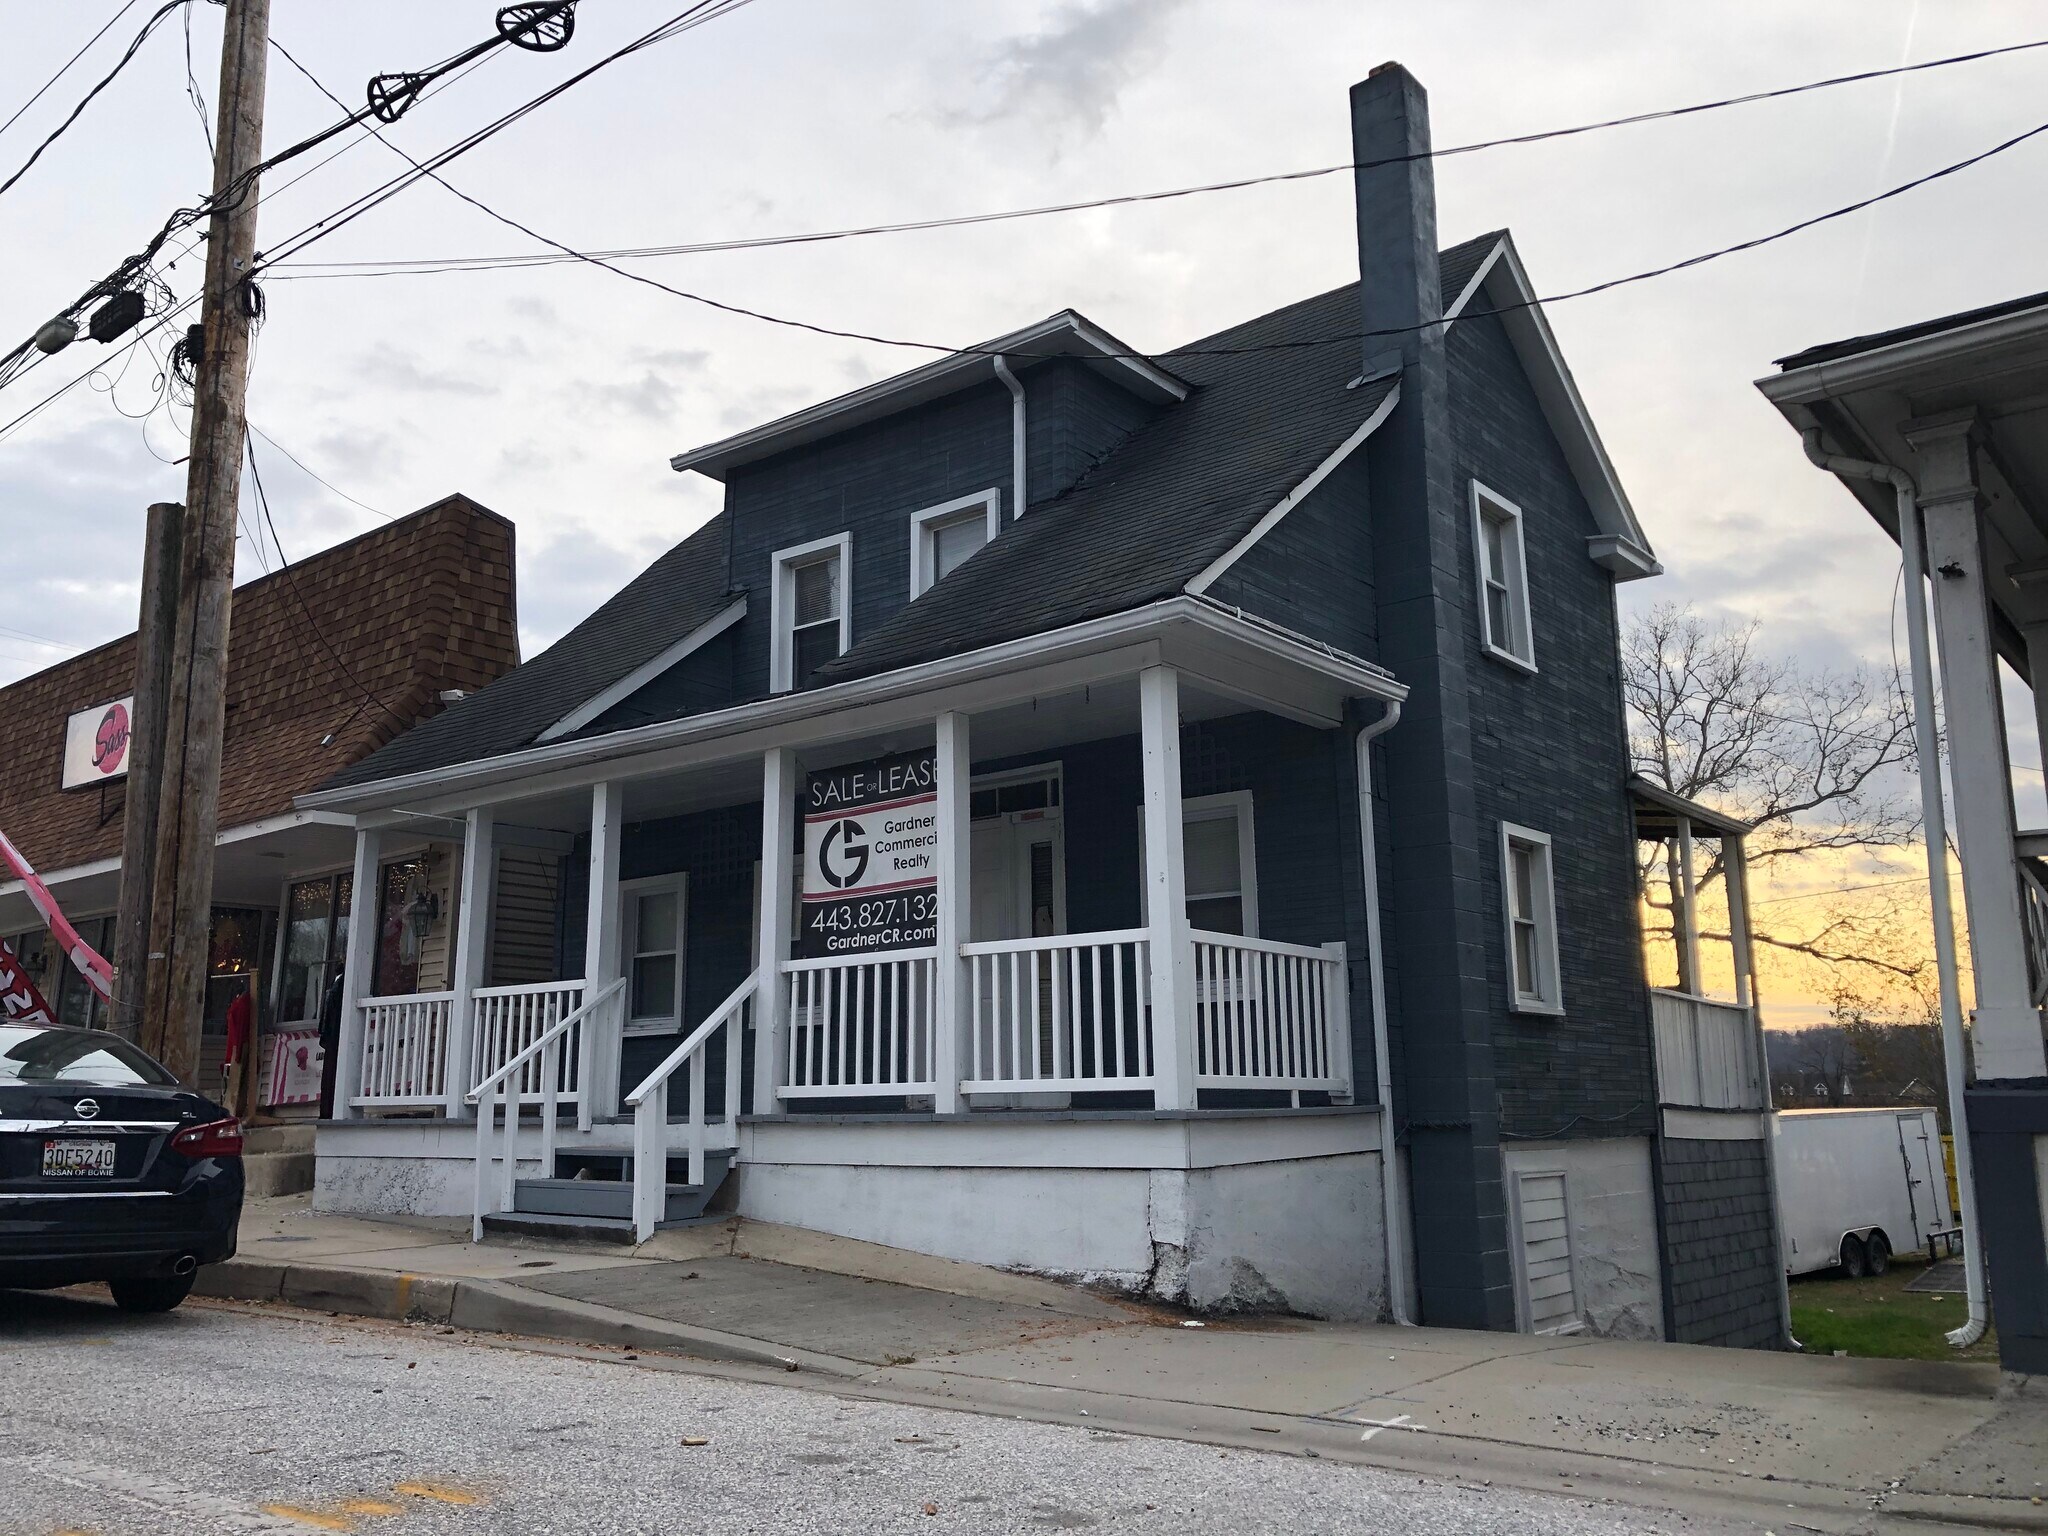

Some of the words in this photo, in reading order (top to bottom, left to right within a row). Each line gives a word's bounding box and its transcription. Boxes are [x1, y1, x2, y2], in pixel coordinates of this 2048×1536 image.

[812, 773, 864, 807] SALE
[866, 782, 878, 793] OR
[884, 815, 936, 835] Gardner
[893, 853, 930, 871] Realty
[827, 926, 935, 951] GardnerCR.com
[45, 1148, 114, 1168] 3DE5240
[43, 1169, 73, 1177] NISSAN
